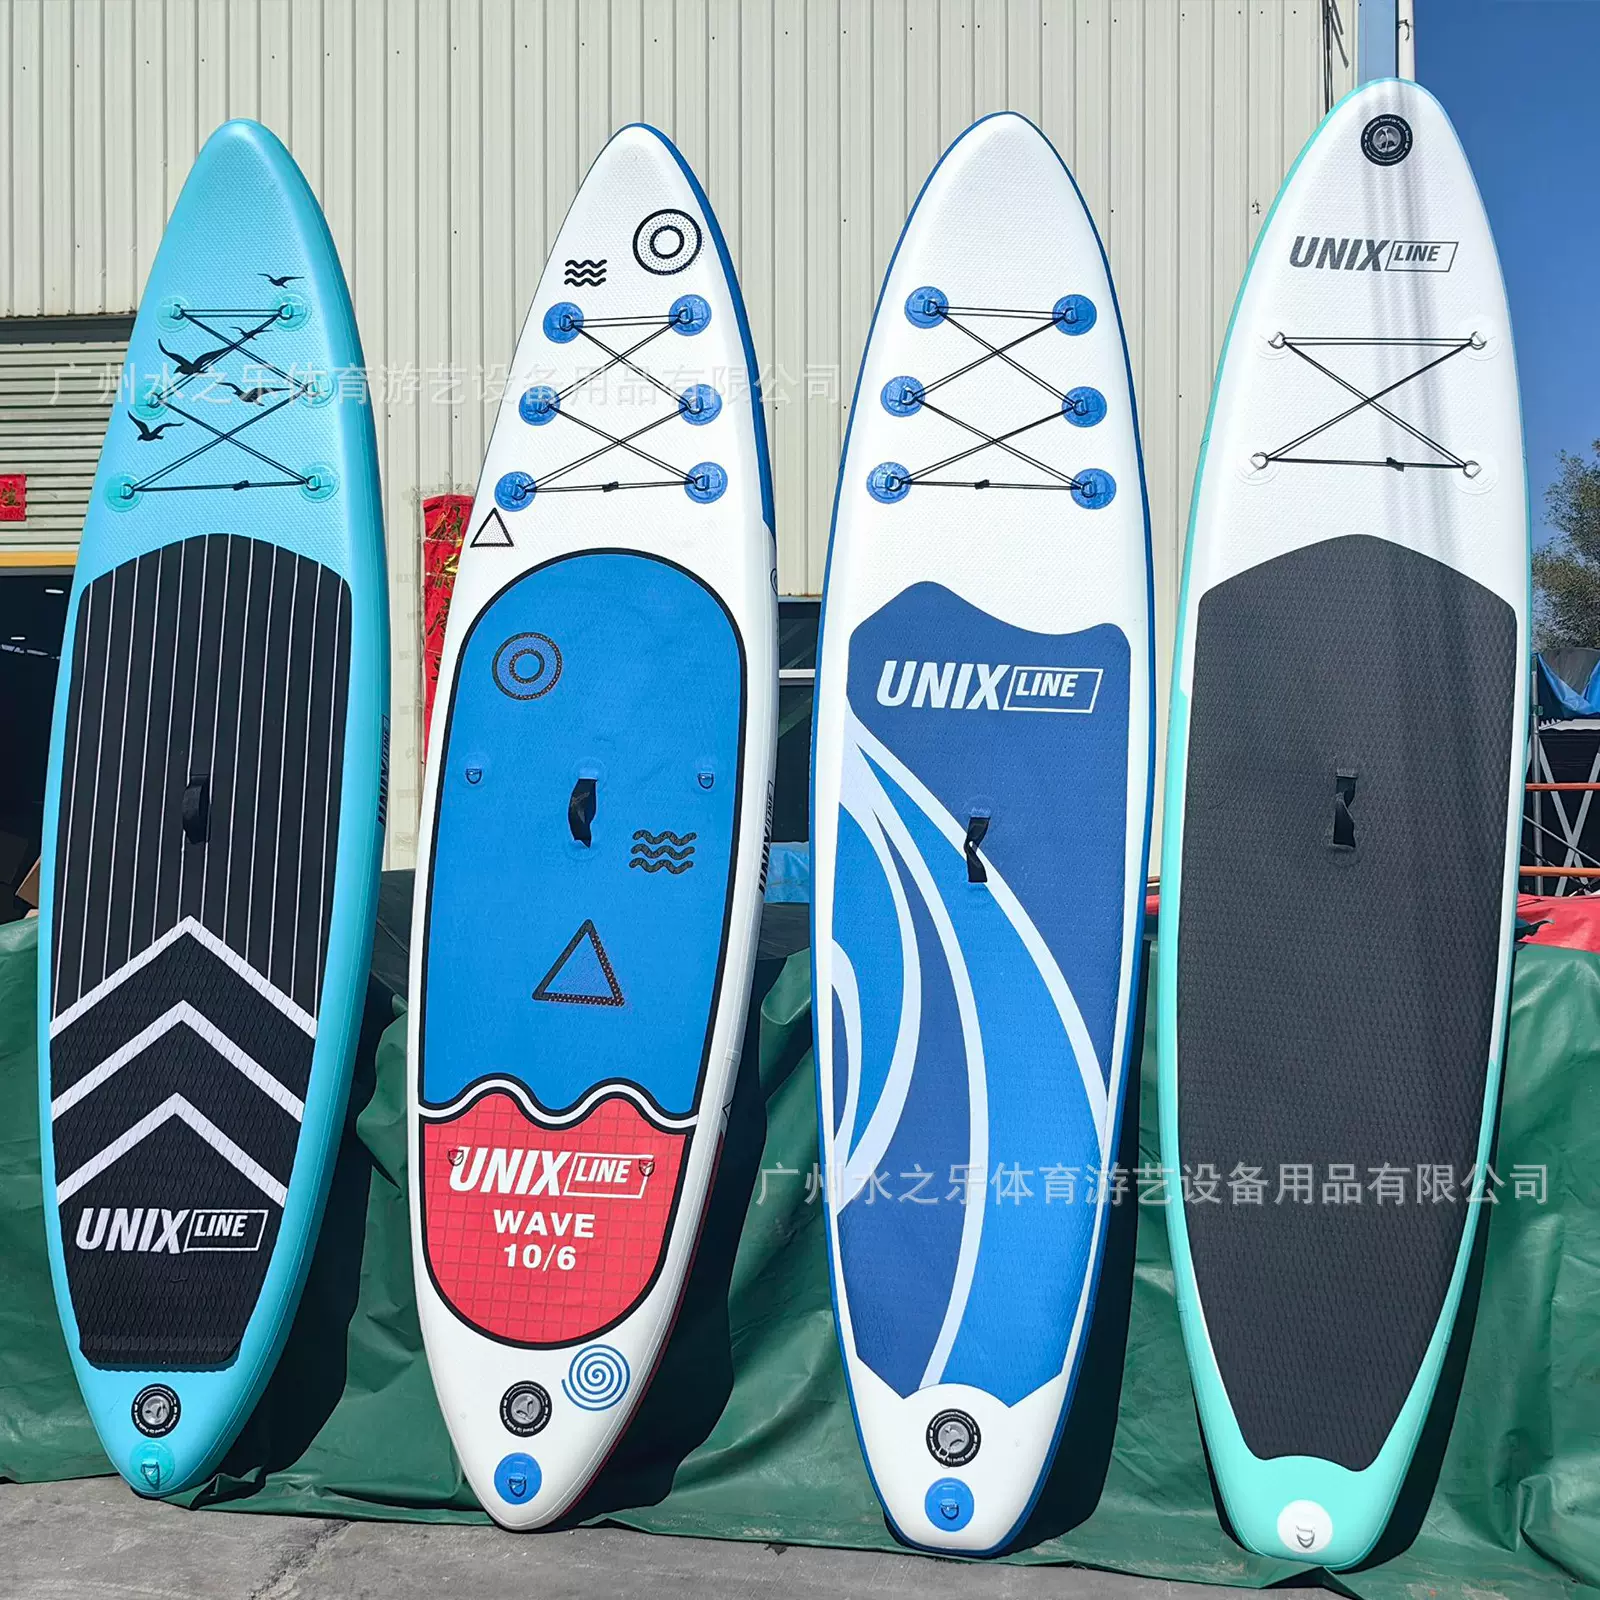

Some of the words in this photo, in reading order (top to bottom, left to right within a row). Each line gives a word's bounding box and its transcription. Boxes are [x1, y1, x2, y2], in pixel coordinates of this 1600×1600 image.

[1289, 236, 1391, 272] UNIX
[1393, 245, 1441, 262] LINE
[876, 660, 1011, 711] UNIX
[1015, 672, 1079, 698] LINE
[449, 1145, 572, 1196] UNIX
[574, 1158, 632, 1184] LINE
[75, 1207, 190, 1254] UNIX
[194, 1214, 248, 1237] LINE
[493, 1209, 596, 1238] WAVE
[503, 1243, 577, 1272] 10/6
